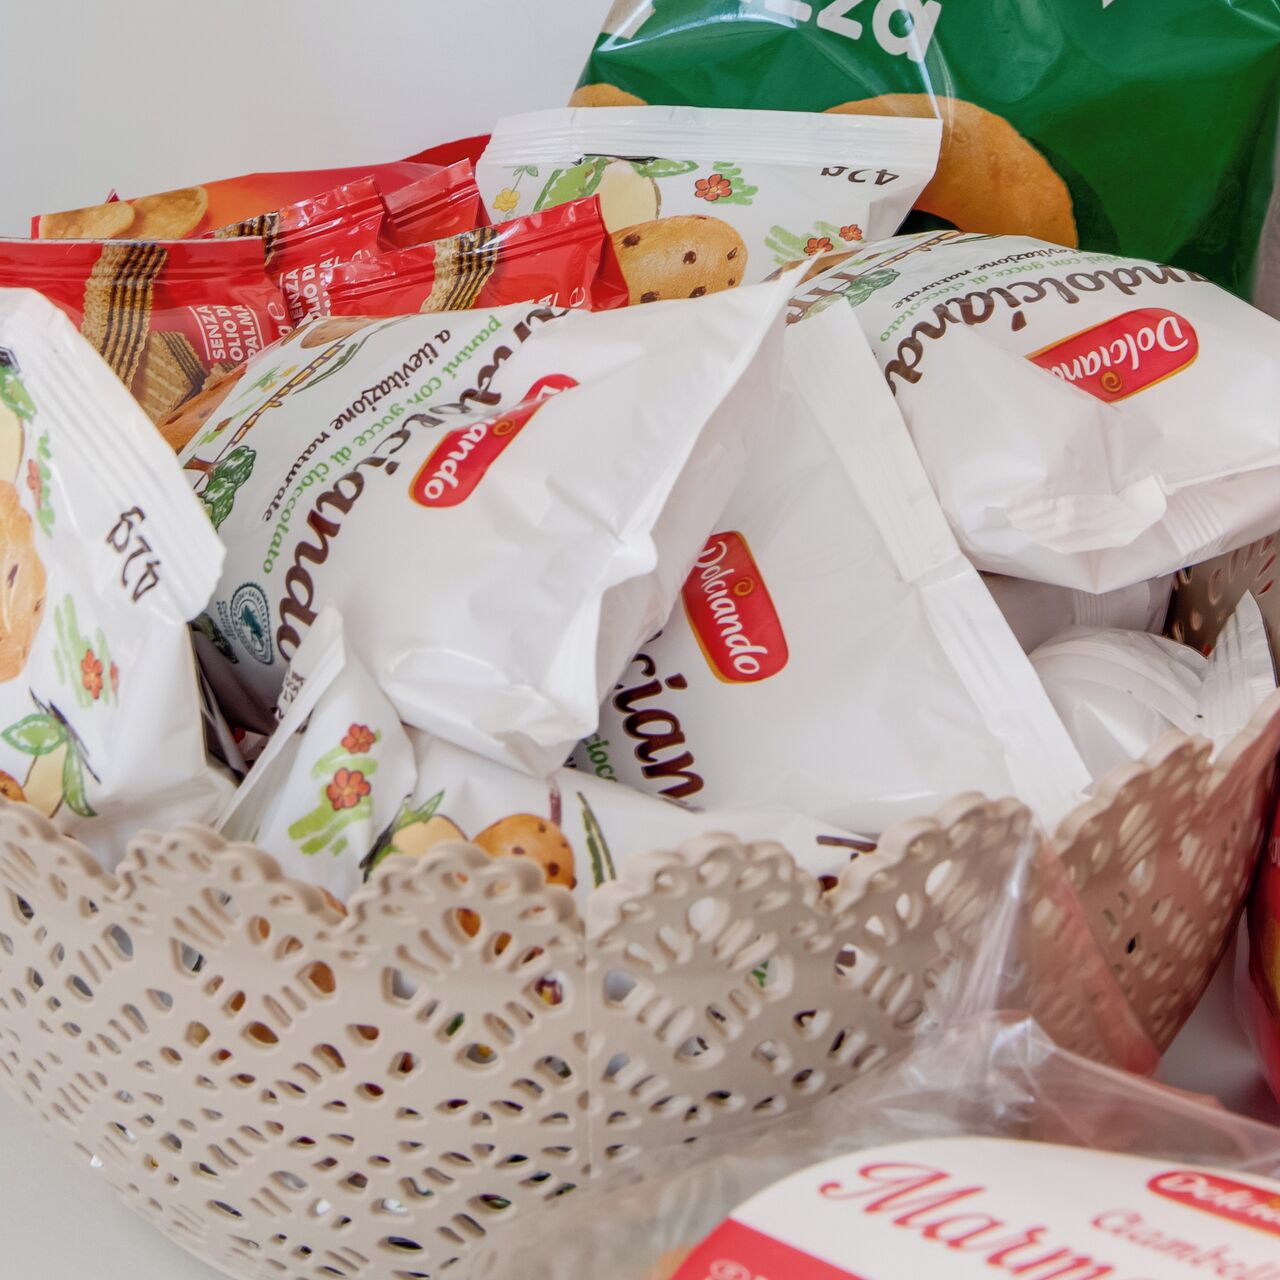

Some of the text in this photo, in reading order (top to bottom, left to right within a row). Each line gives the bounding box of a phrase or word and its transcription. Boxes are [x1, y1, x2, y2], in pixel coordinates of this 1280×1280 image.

[892, 269, 973, 310] naturale
[971, 274, 989, 286] di
[994, 261, 1046, 279] gocce
[1049, 256, 1081, 267] con
[197, 306, 228, 361] SENZA
[212, 305, 244, 362] OLIO DI
[234, 305, 258, 360] PALMA
[879, 280, 966, 343] cioccolato
[442, 315, 503, 379] panini
[262, 329, 451, 522] a lievitazione naturale
[353, 404, 405, 447] gocce
[329, 446, 352, 466] di
[262, 462, 330, 574] cioccolato
[106, 506, 160, 602] 42g
[696, 540, 769, 675] Dolciando
[817, 1161, 1116, 1280] Marm
